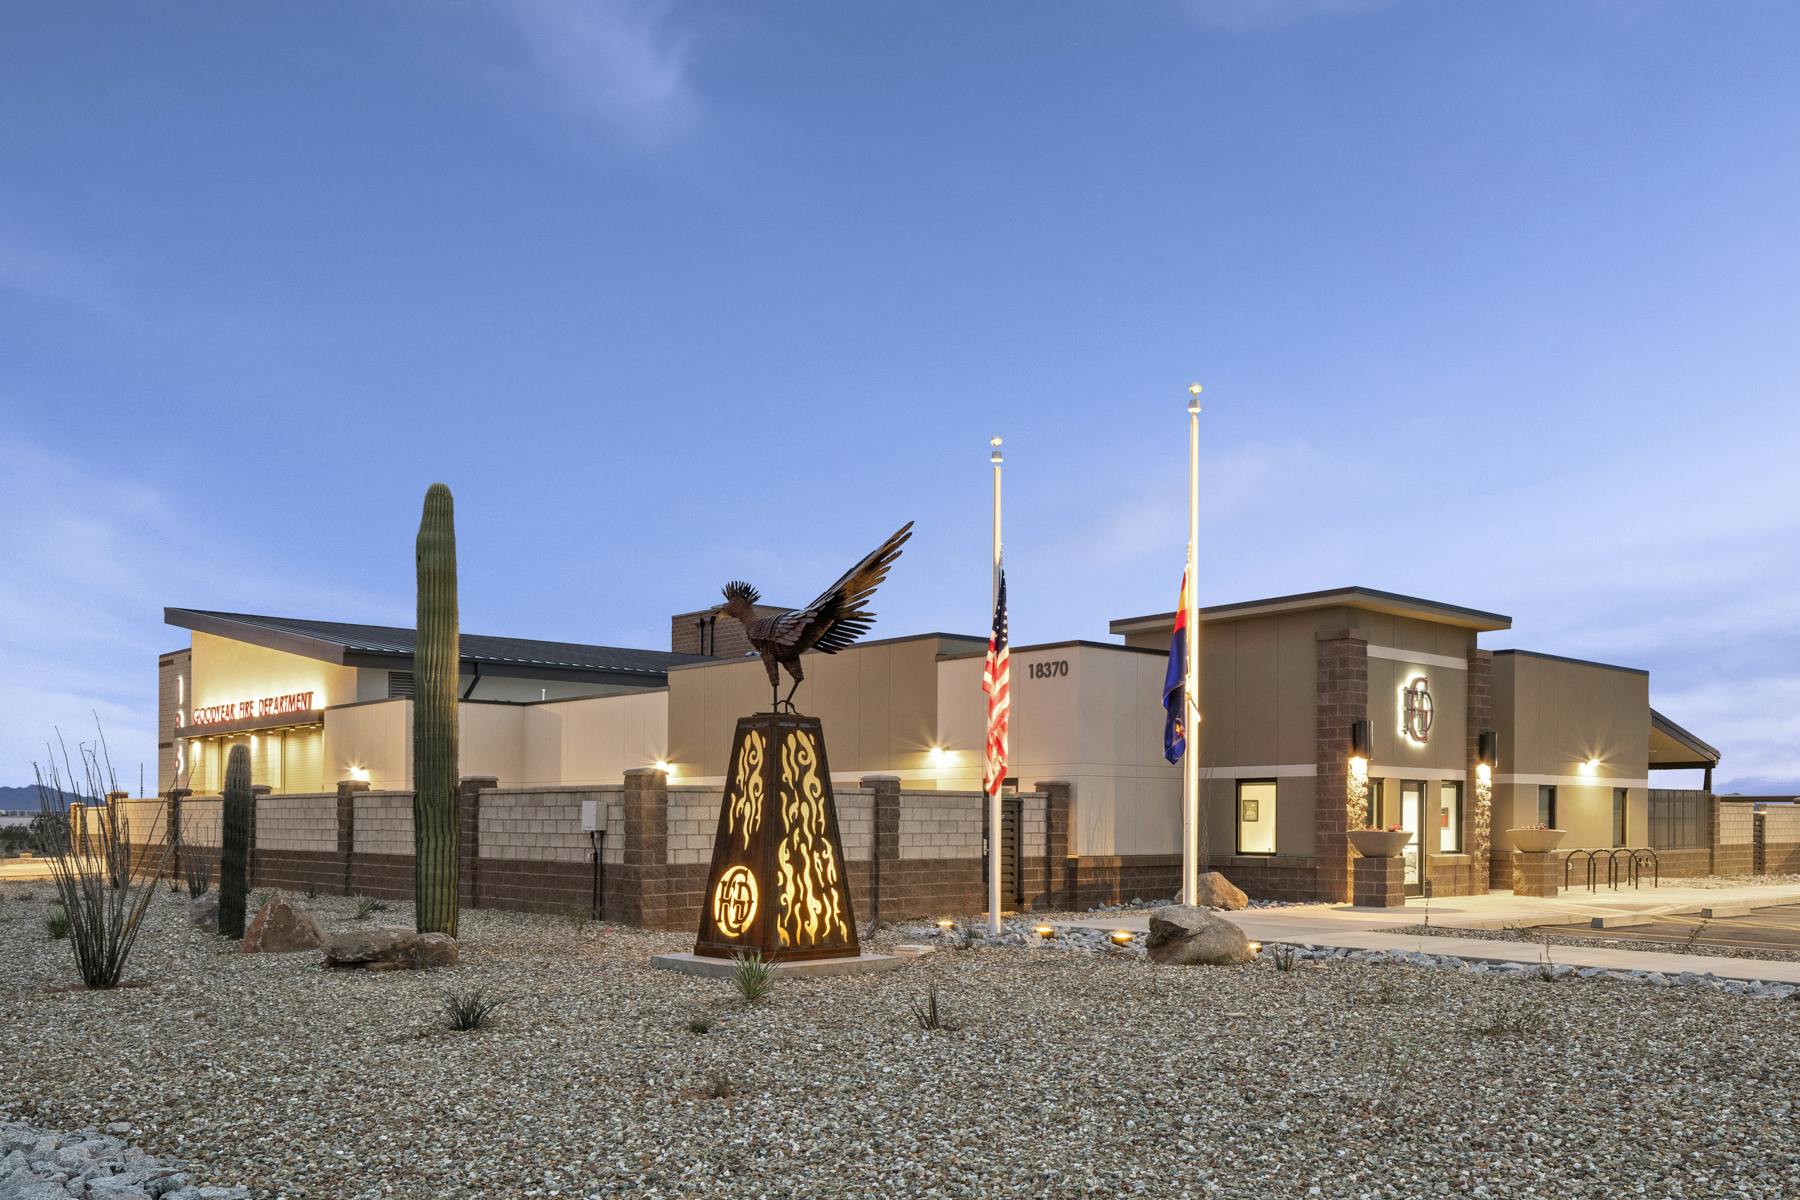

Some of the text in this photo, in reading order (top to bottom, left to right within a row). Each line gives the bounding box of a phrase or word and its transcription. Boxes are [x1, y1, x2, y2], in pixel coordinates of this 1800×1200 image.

[1028, 660, 1069, 680] 18370
[192, 691, 314, 726] GOODYEAR FIRE DEPARTMENT
